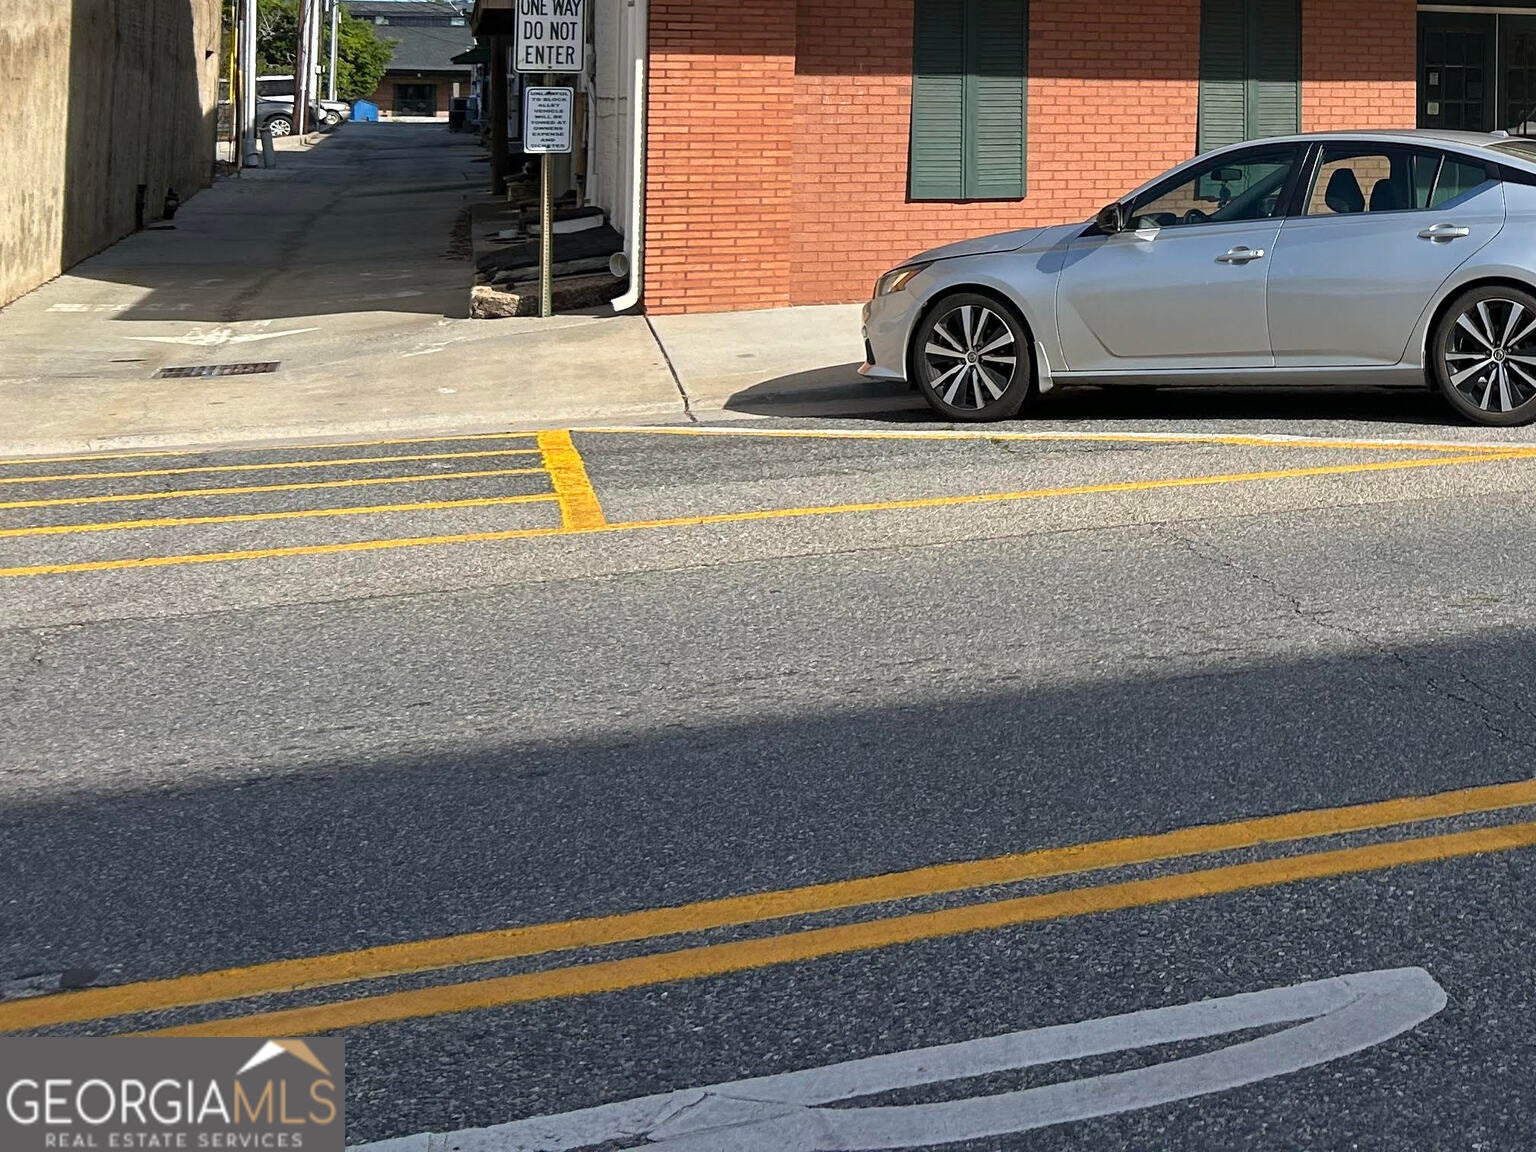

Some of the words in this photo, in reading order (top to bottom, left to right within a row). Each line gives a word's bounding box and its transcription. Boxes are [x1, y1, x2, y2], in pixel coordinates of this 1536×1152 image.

[524, 21, 543, 40] DO
[550, 21, 577, 41] NOT
[525, 45, 575, 65] ENTER
